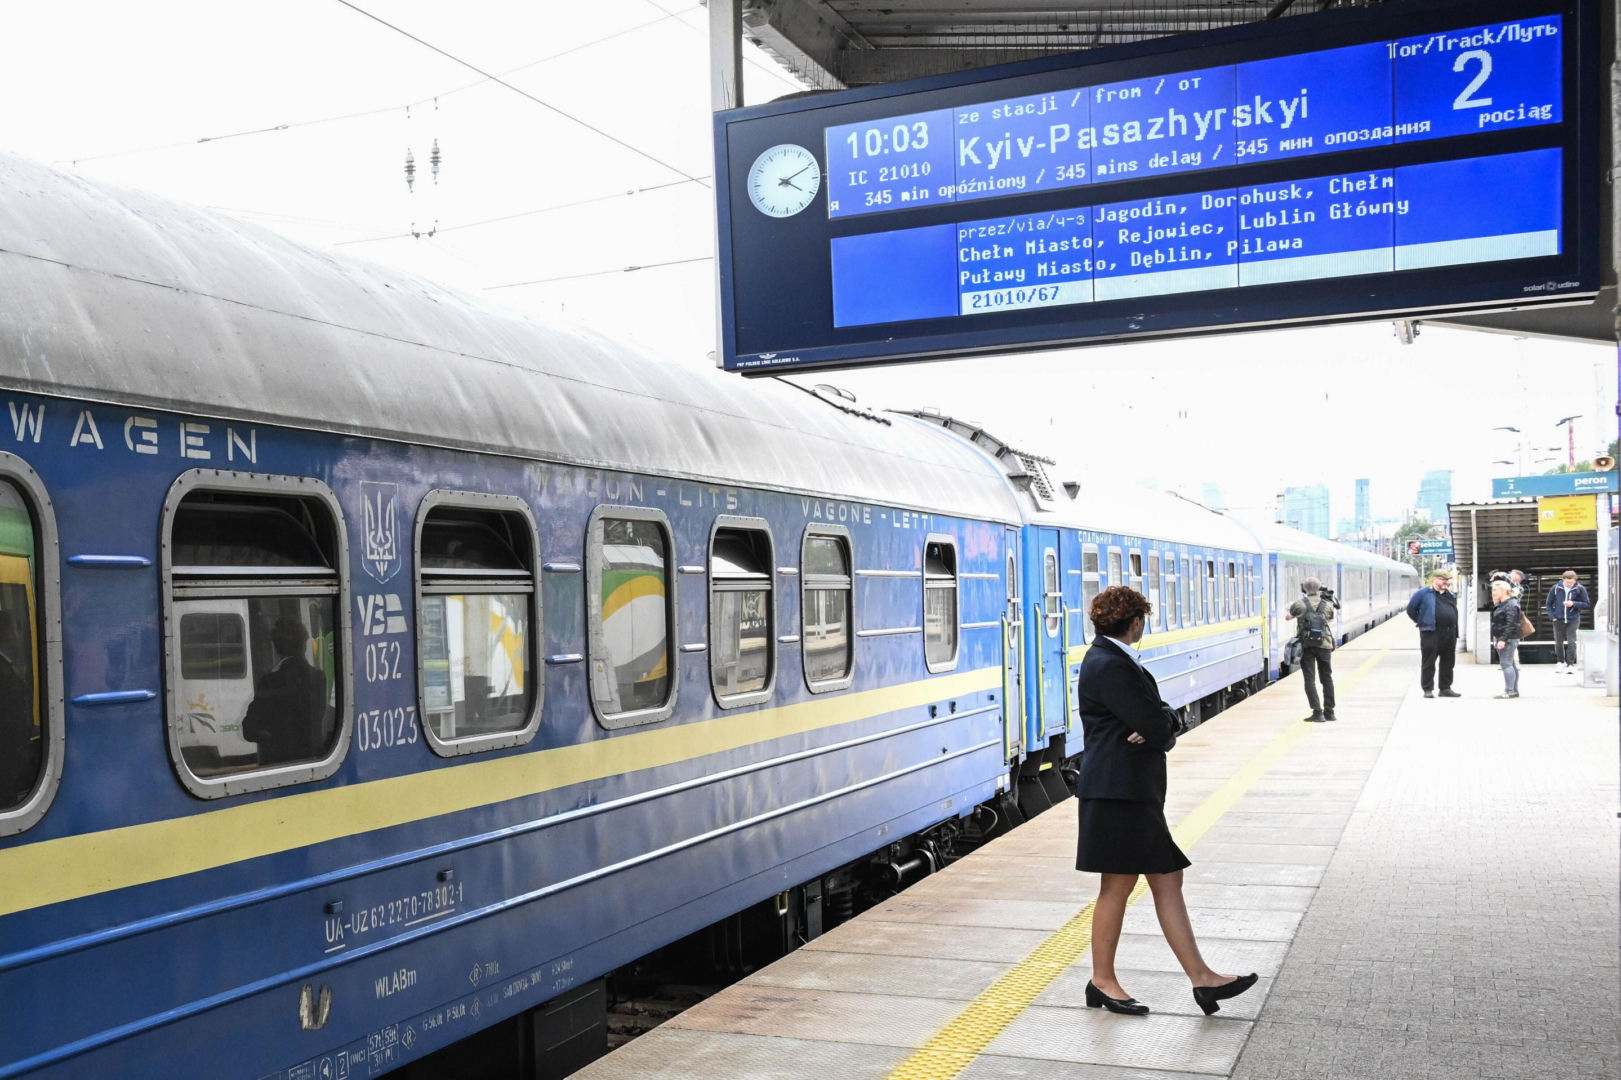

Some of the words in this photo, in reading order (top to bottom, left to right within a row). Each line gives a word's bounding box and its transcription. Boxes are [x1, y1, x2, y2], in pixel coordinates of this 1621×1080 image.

[1452, 49, 1493, 111] 2
[959, 111, 980, 125] ze
[992, 96, 1058, 120] stacji
[1095, 86, 1141, 104] from
[1479, 103, 1553, 128] pociąg
[846, 121, 929, 159] 10:03
[959, 88, 1308, 170] Kyiv-Pasazhyrskyi
[848, 170, 868, 187] IC
[879, 161, 931, 182] 21010
[865, 191, 893, 206] 345
[901, 187, 929, 202] min
[938, 173, 1027, 199] opóźniony
[1056, 163, 1086, 182] 345
[1097, 154, 1138, 175] mins
[1148, 147, 1202, 169] delay
[1235, 138, 1268, 157] 345
[1325, 120, 1431, 145] опоздания
[1095, 201, 1187, 225] Jagodin,
[1202, 184, 1314, 210] Dorohusk,
[1330, 174, 1394, 195] Chełm
[959, 244, 1015, 263] Chełm
[1026, 235, 1105, 255] Miasto,
[1119, 221, 1225, 245] Rejowiec,
[1240, 207, 1316, 230] Lublin
[1330, 198, 1410, 220] Główny
[960, 267, 1026, 286] Puławy
[1038, 257, 1117, 278] Miasto,
[1131, 246, 1213, 269] Dęblin,
[1227, 236, 1303, 256] Pilawa
[972, 286, 1060, 309] 21010/67
[8, 401, 257, 464] WAGEN
[1574, 476, 1607, 487] peron
[365, 641, 402, 683] 032
[357, 705, 418, 752] 03023
[325, 910, 369, 943] UA-UZ
[374, 968, 417, 999] WLABm
